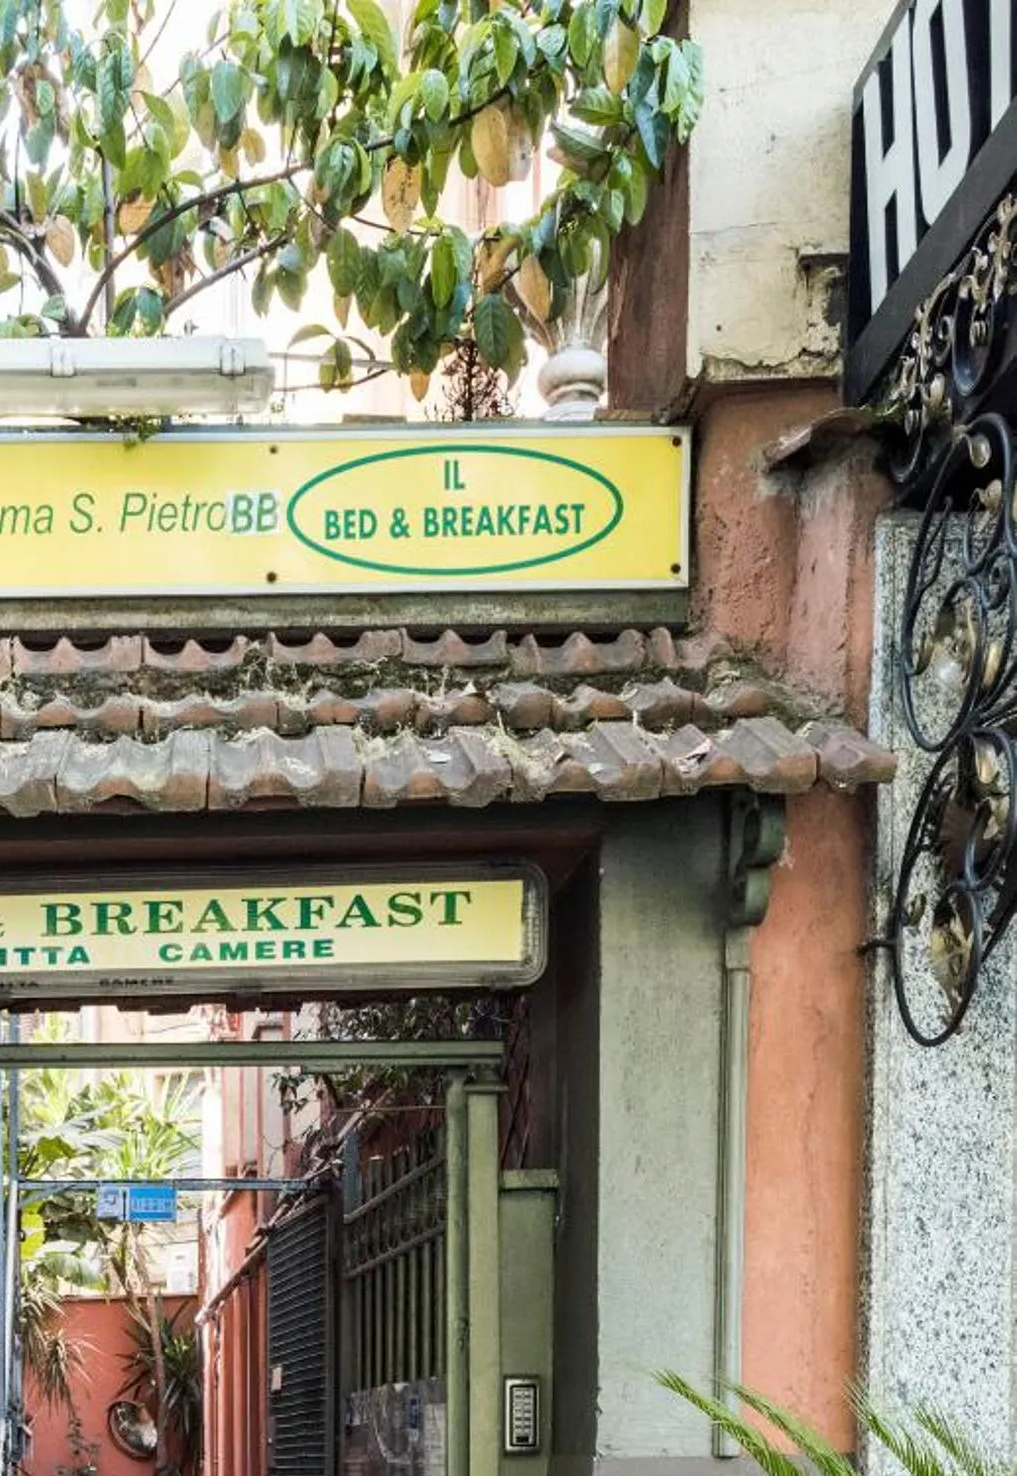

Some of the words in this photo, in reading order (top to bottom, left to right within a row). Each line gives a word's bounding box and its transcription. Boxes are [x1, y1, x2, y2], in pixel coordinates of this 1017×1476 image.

[444, 459, 466, 491] IL
[69, 492, 103, 534] S.
[325, 507, 378, 541] BED
[389, 506, 411, 540] &
[423, 501, 585, 538] BREAKFAST
[42, 889, 473, 938] BREAKFAST
[158, 938, 337, 963] CAMERE
